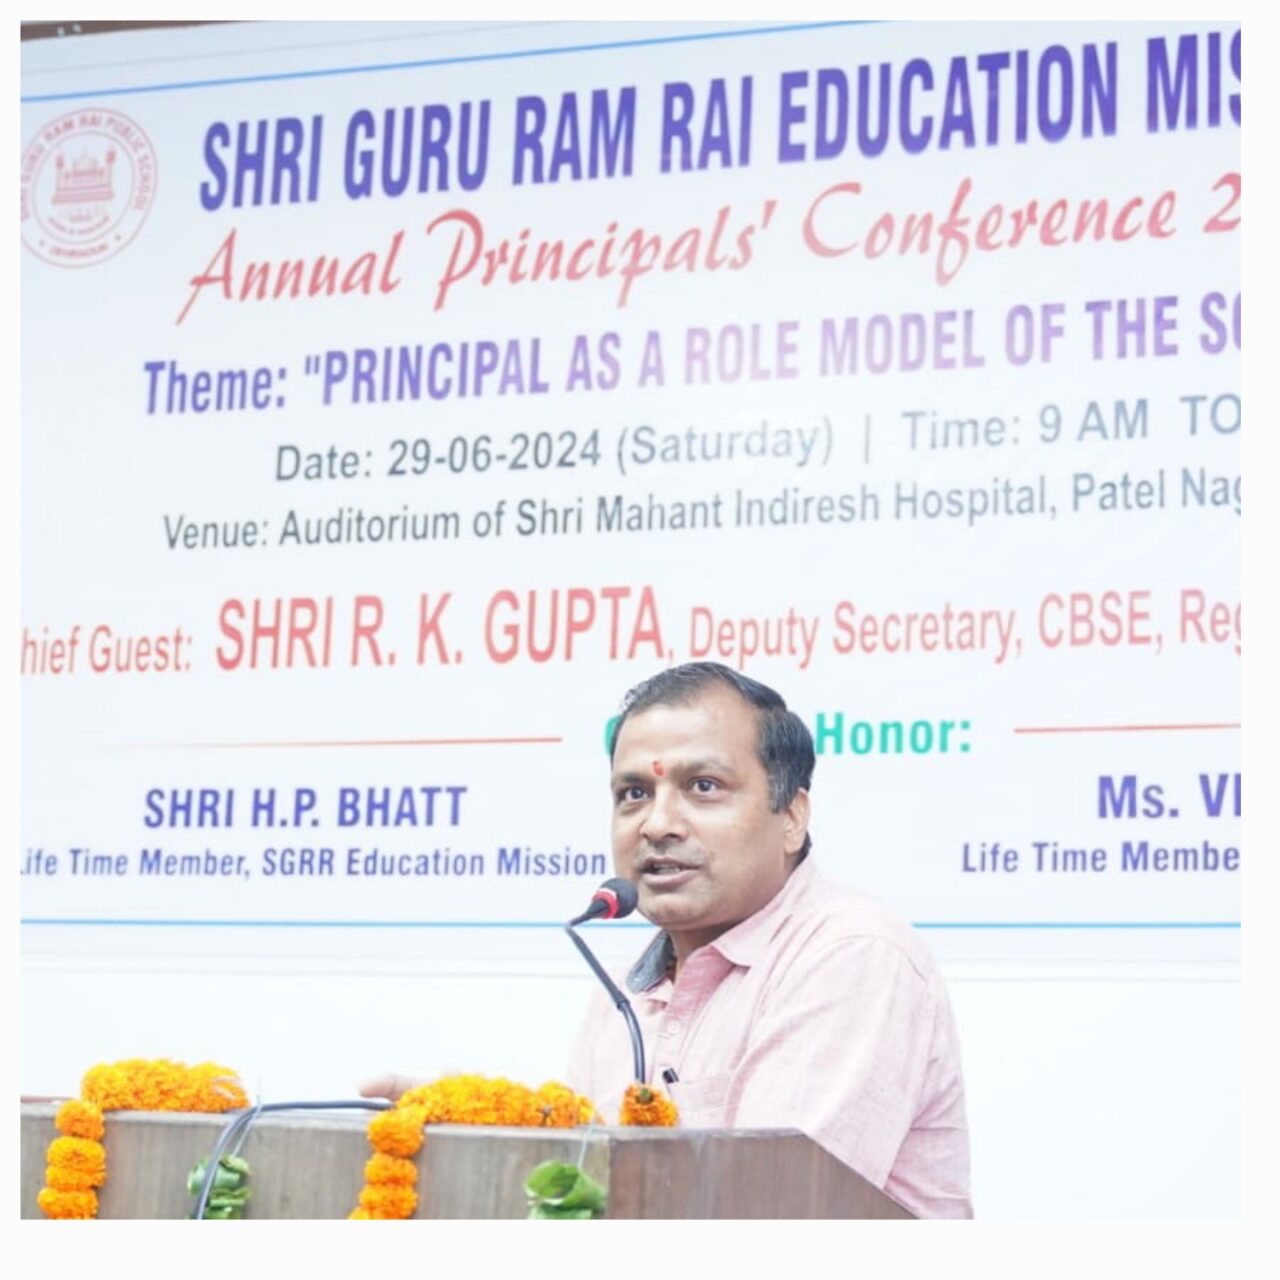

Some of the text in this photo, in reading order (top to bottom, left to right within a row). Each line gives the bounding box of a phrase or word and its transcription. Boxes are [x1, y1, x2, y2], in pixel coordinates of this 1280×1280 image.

[200, 42, 1117, 211] SHRI GURU RAM RAI EDUCATION
[176, 177, 1176, 325] Annual Principals' Conference
[144, 296, 1178, 414] Theme: "PRINCIPAL AS A ROLE MODEL OF THE
[89, 586, 1162, 673] Guest: SHRI R. K. GUPTA, Deputy Secretary, CBSE,
[816, 712, 970, 758] Honor:
[69, 847, 607, 877] Time Member, SGRR Education Mission
